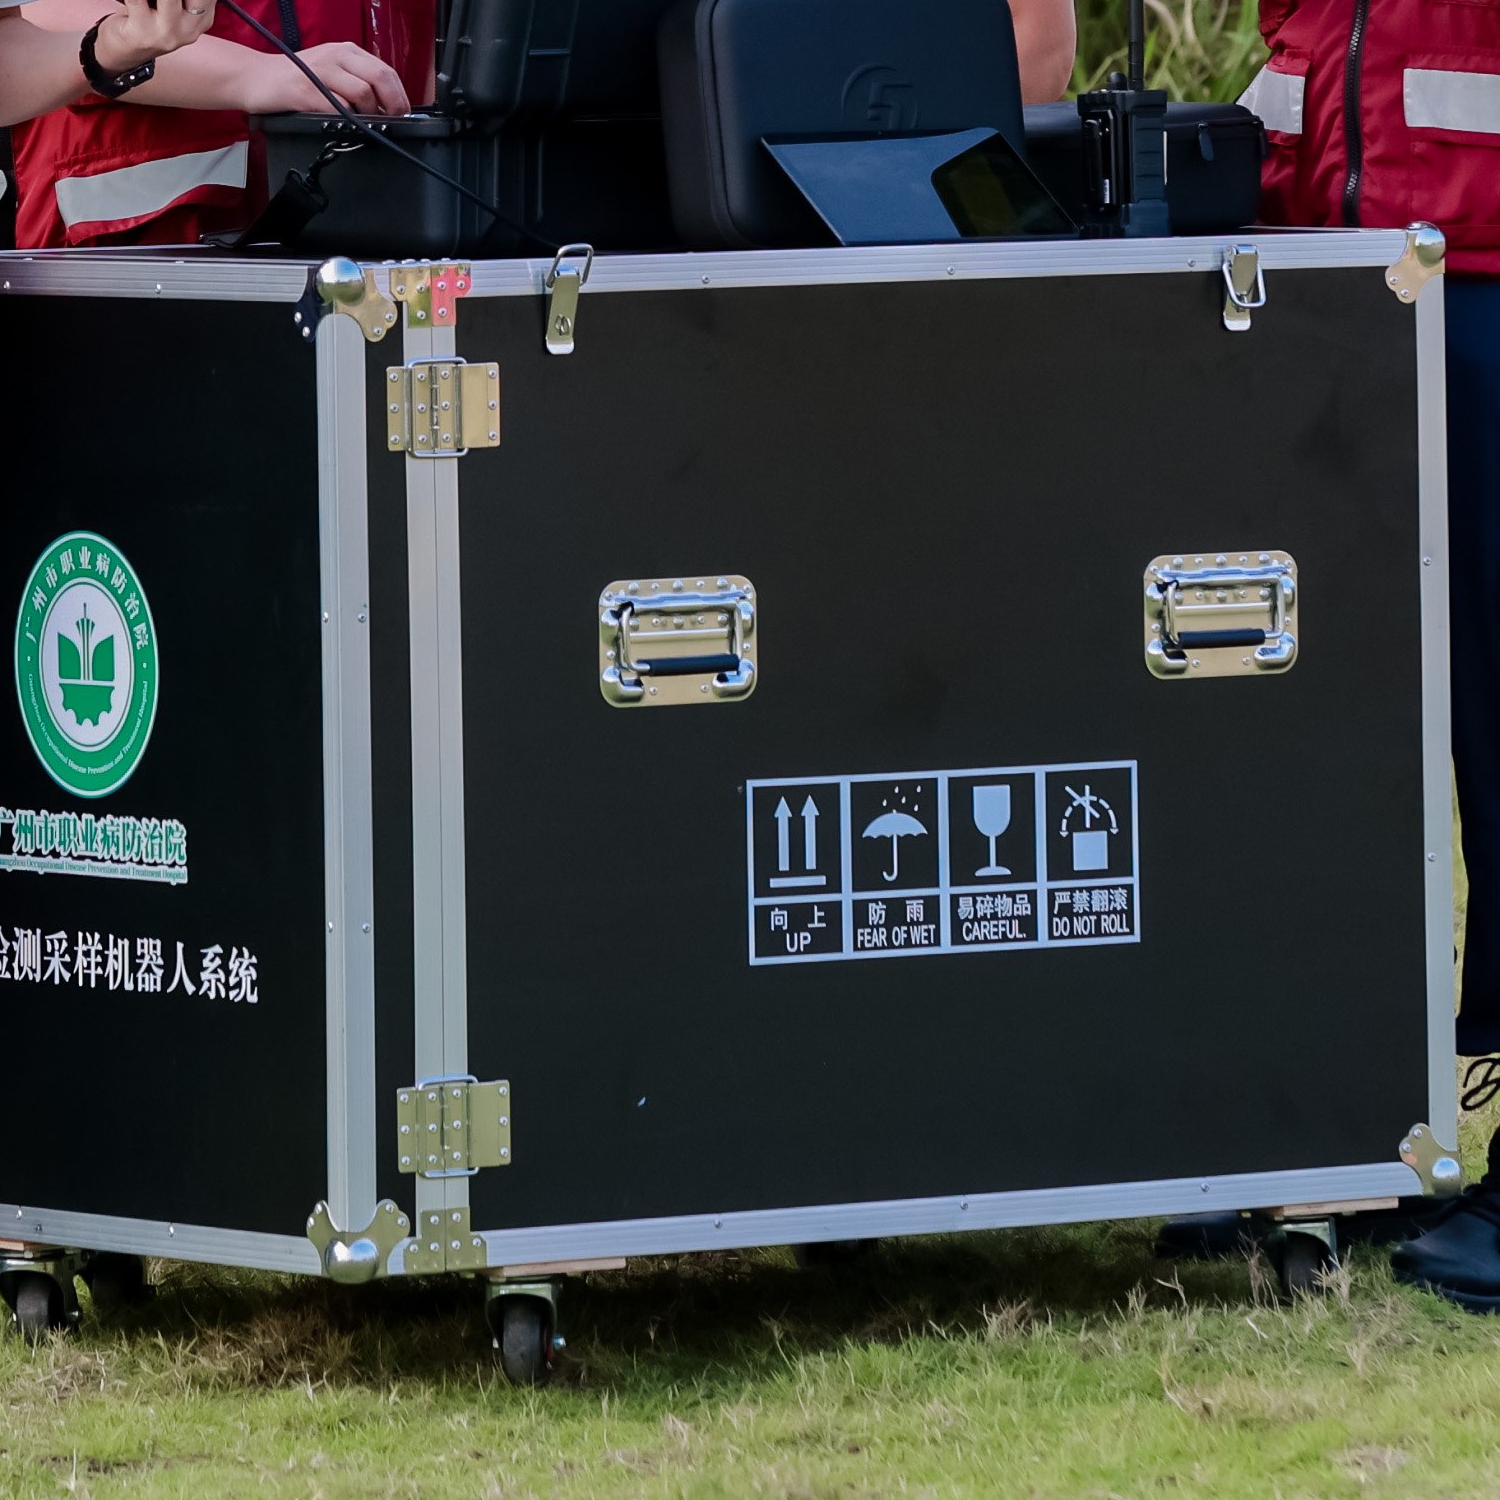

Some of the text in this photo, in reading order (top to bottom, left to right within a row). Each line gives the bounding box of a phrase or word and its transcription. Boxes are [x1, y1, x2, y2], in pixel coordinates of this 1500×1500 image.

[958, 893, 1031, 920] 易碎物品
[1054, 888, 1129, 915] 严禁翻滚
[857, 924, 936, 949] FEAR OF WET
[962, 919, 1027, 941] CAREFUL.
[1053, 913, 1130, 937] DO NOT ROLL
[786, 933, 812, 953] UP
